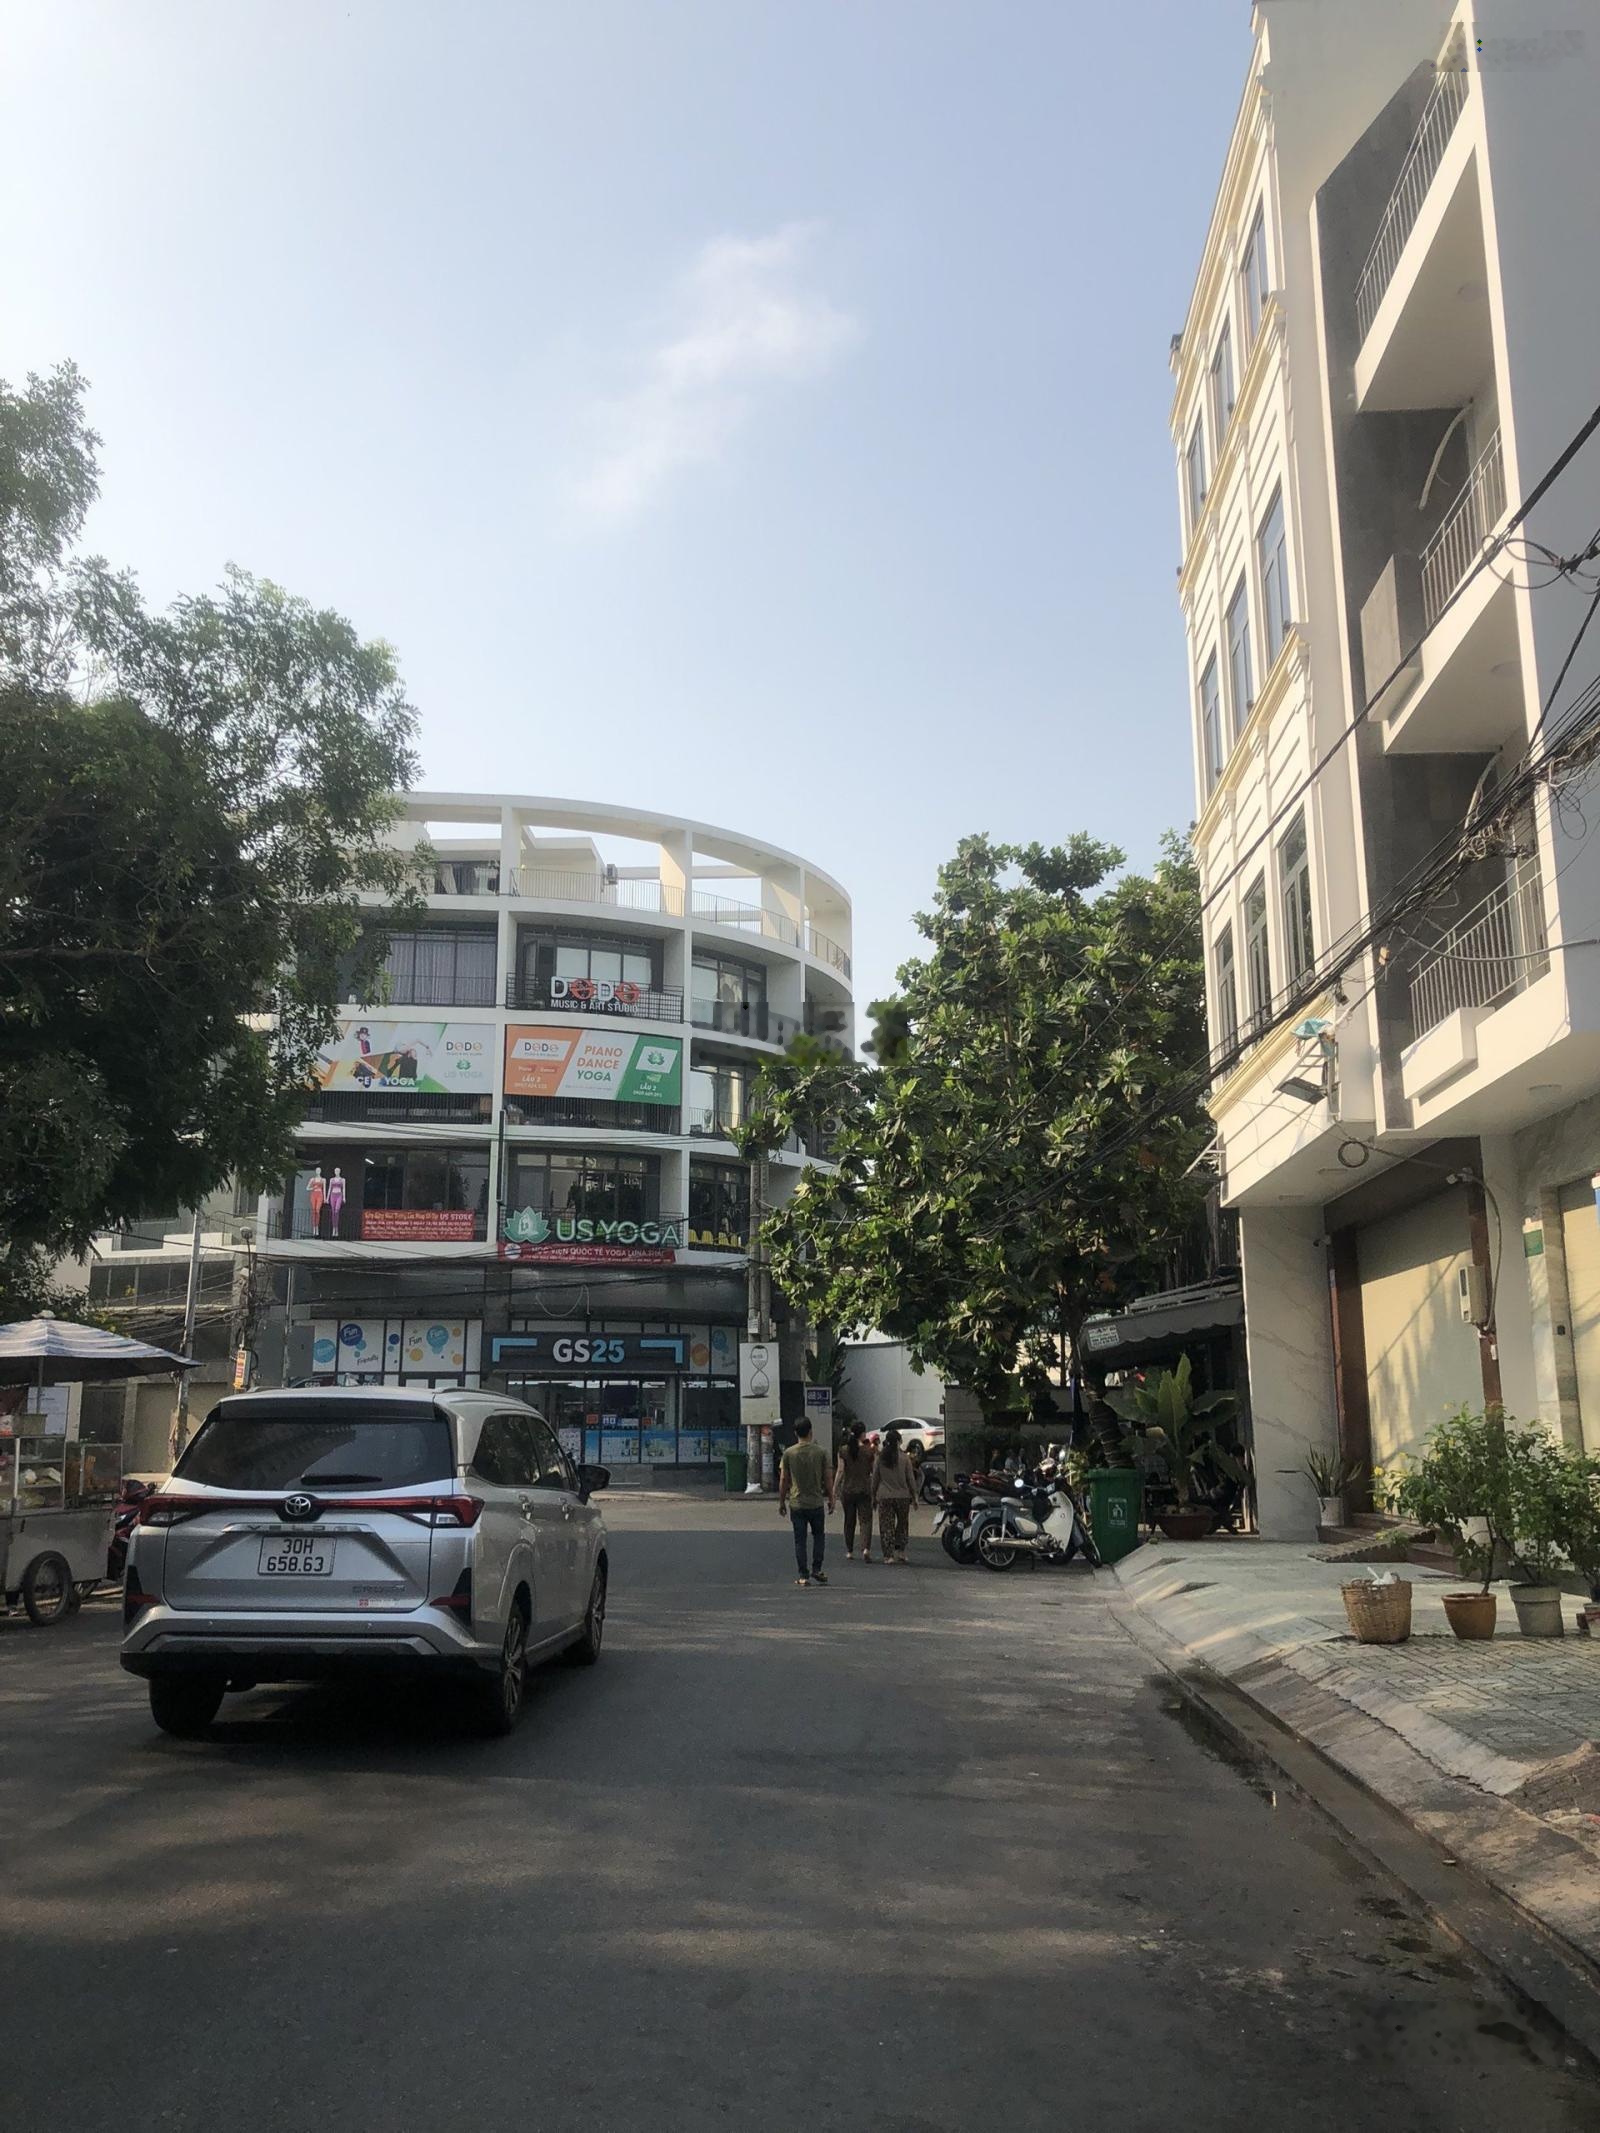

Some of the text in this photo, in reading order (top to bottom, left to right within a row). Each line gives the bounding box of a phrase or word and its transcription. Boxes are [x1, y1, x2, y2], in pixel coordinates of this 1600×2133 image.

[550, 1000, 639, 1013] MUSIC & ART STUDIO
[584, 1045, 623, 1057] PIANO
[577, 1058, 620, 1069] DANCE
[577, 1070, 612, 1081] YOGA
[385, 1076, 416, 1087] YOGA
[556, 1218, 681, 1245] US YOGA
[605, 1248, 626, 1257] YOGA
[343, 1328, 358, 1338] Fun
[408, 1336, 422, 1346] Fun
[553, 1338, 625, 1363] GS25
[282, 1539, 314, 1554] 30H
[267, 1556, 324, 1572] 658.63
